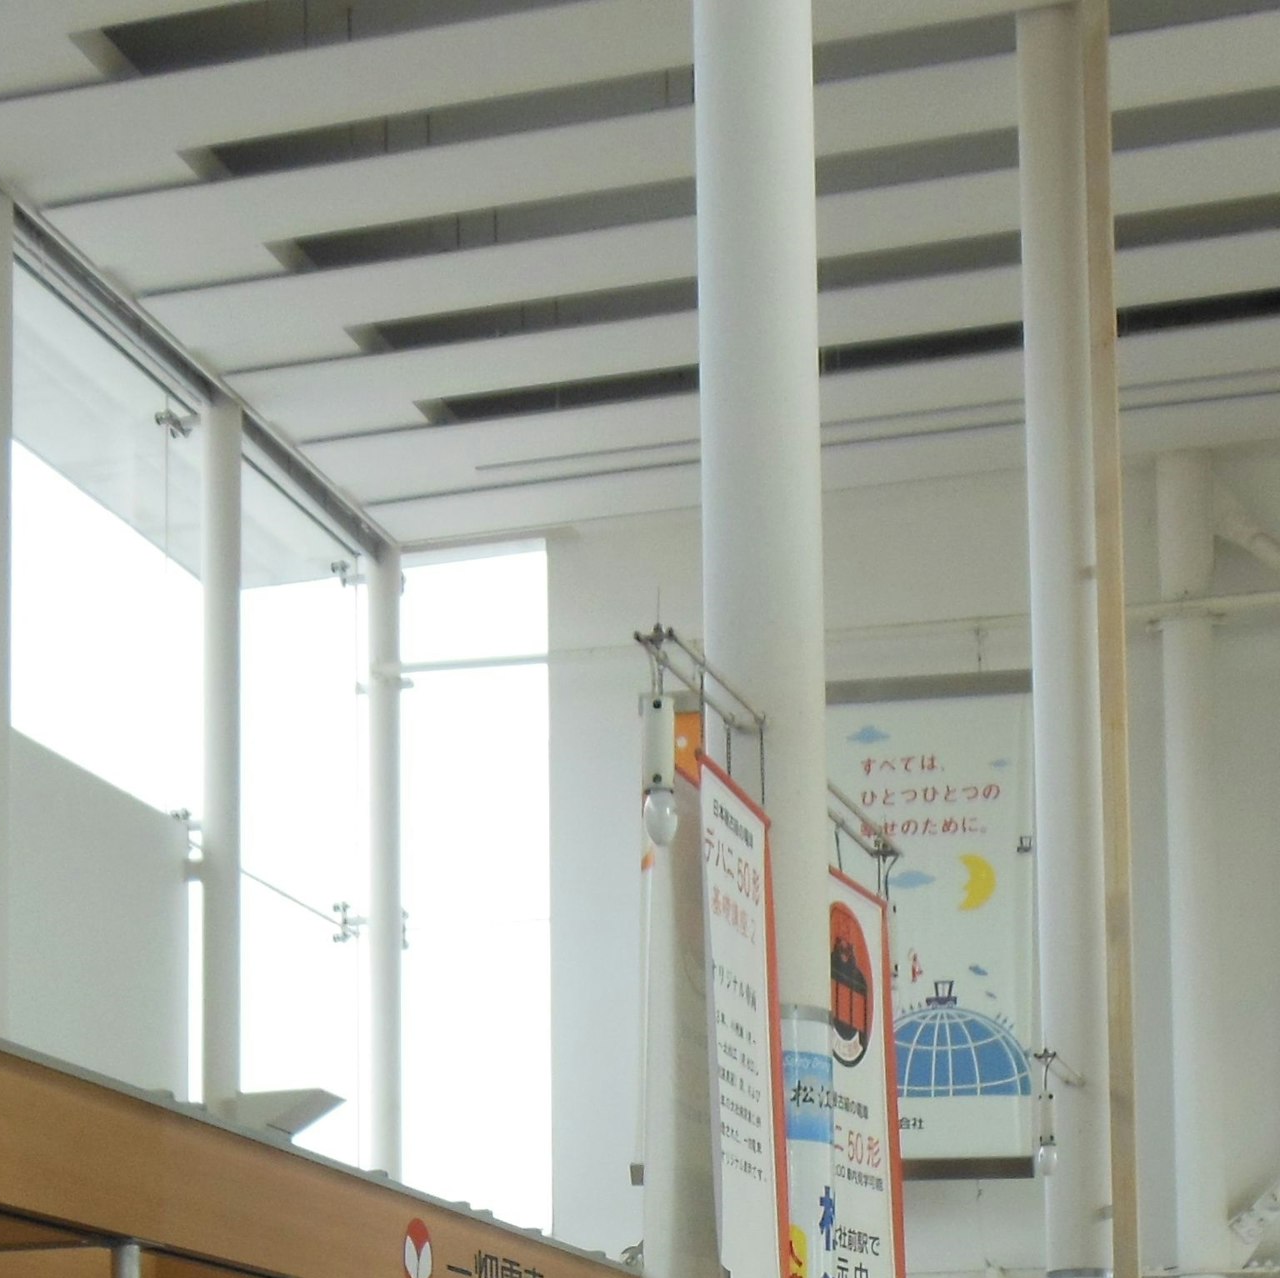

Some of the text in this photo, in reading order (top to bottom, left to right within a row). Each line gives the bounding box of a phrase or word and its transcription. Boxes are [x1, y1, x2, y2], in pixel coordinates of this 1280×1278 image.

[861, 783, 1001, 807] ひとつひとつの
